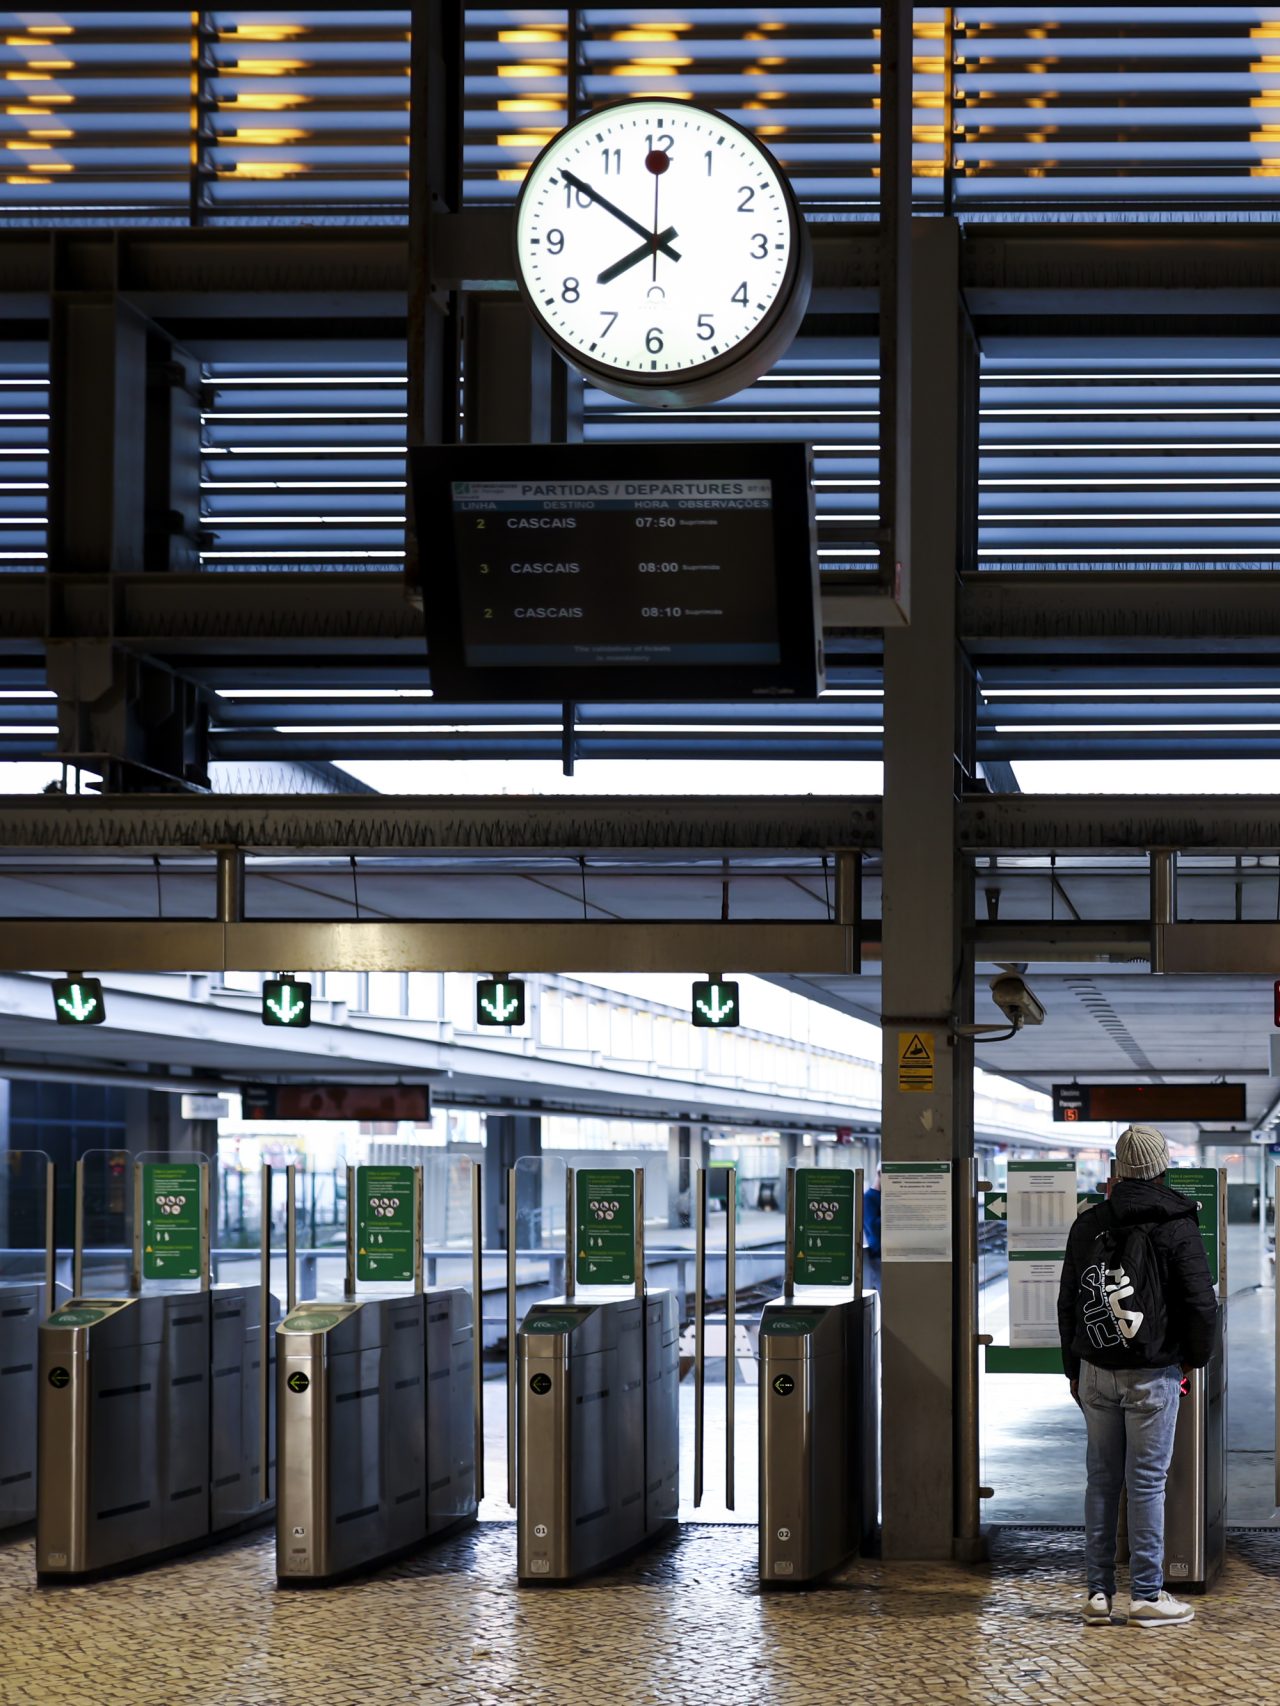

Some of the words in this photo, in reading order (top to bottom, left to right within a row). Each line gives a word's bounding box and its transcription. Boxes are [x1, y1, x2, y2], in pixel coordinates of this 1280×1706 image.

[602, 149, 622, 175] 11
[704, 151, 713, 176] 1
[737, 186, 755, 212] 2
[546, 229, 565, 255] 9
[750, 233, 769, 259] 3
[561, 277, 580, 303] 8
[731, 281, 750, 308] 4
[600, 312, 619, 339] 7
[696, 314, 715, 340] 5
[645, 328, 664, 354] 6
[521, 484, 609, 497] PARTIDAS
[625, 483, 743, 495] DEPARTURES
[461, 502, 497, 510] LINHA
[543, 501, 595, 510] DESTINO
[634, 500, 669, 509] HORA
[678, 499, 769, 509] OBSERVAÇÕES
[476, 518, 486, 529] 2
[506, 518, 577, 529] CASCAIS
[635, 517, 676, 528] 07:50
[479, 564, 489, 574] 3
[510, 563, 580, 574] CASCAIS
[638, 562, 679, 573] 08:00
[484, 608, 493, 618] 2
[514, 608, 583, 618] CASCAIS
[641, 607, 682, 617] 08:10
[1081, 1265, 1120, 1349] FILA
